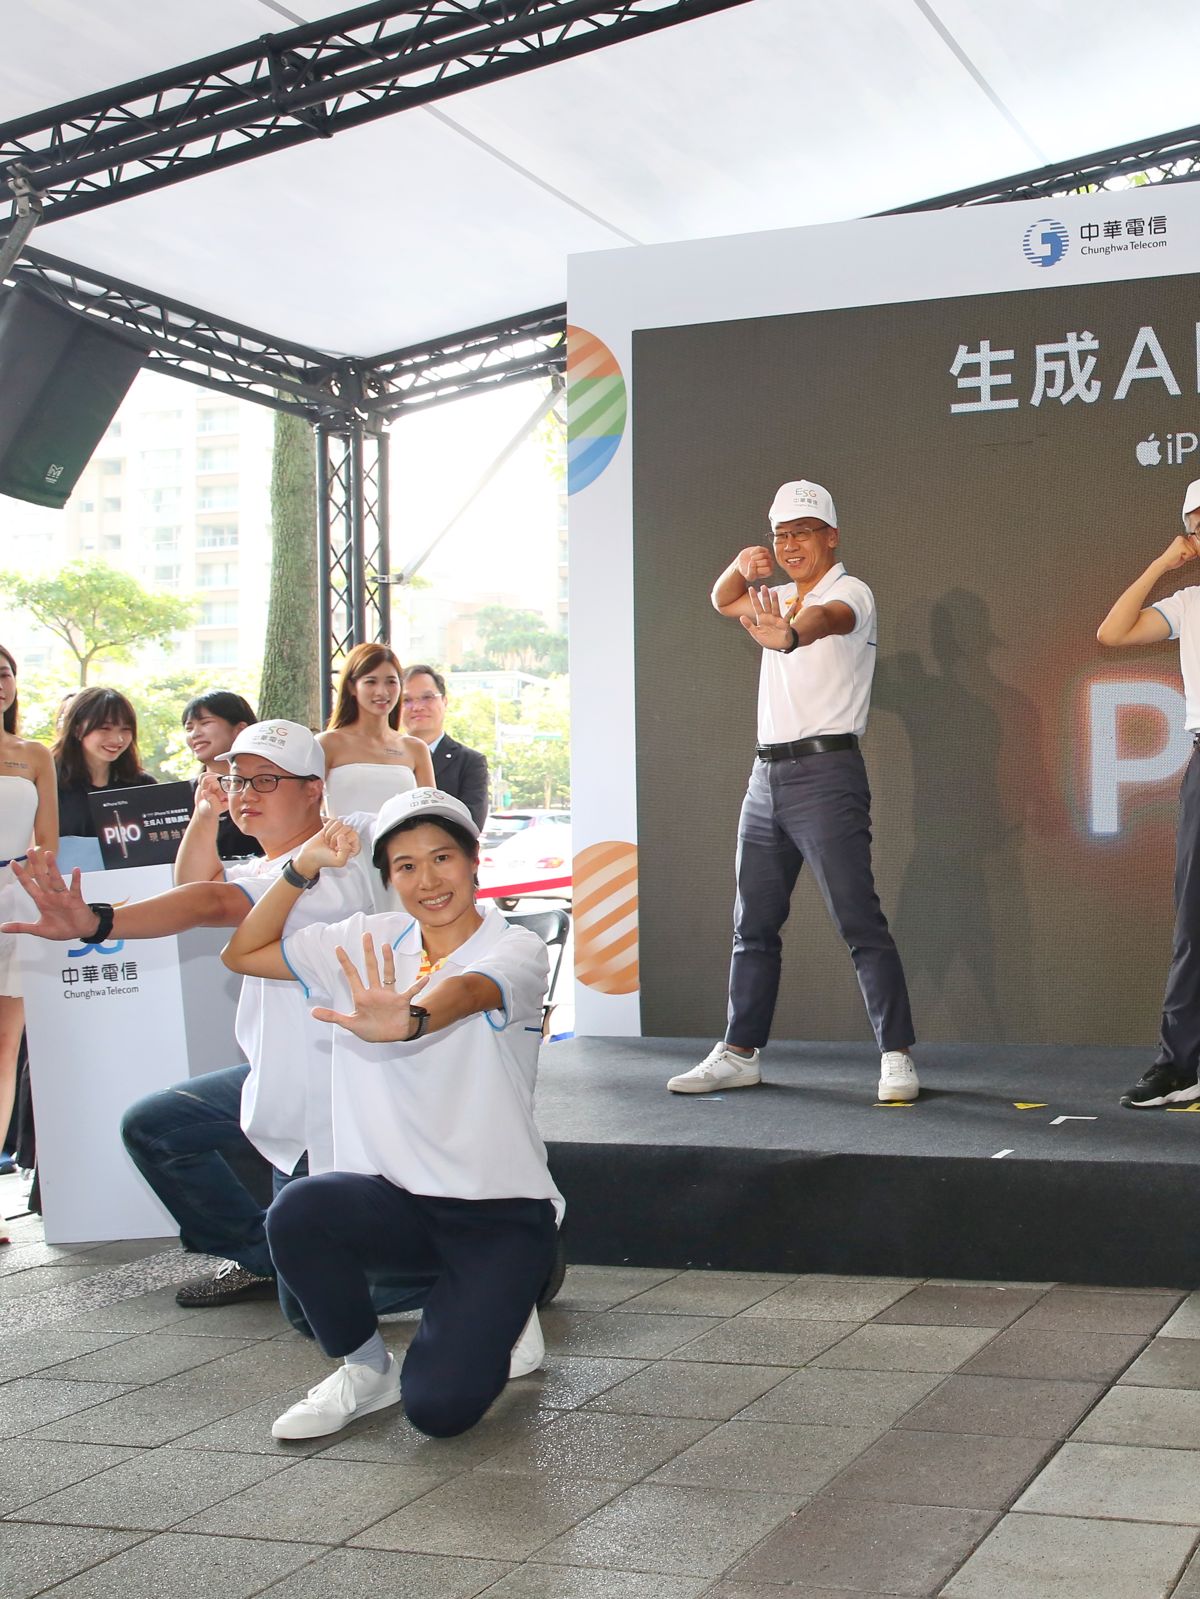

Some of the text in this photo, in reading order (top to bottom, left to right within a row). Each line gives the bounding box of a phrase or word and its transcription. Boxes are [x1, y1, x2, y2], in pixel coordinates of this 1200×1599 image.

[1080, 215, 1168, 242] 中華電信
[1080, 240, 1167, 256] Chunghwa Telecom
[795, 487, 817, 498] ESG
[412, 790, 445, 800] ESG
[61, 961, 138, 986] 中華電信
[63, 985, 140, 1000] Chunghwa Telecom
